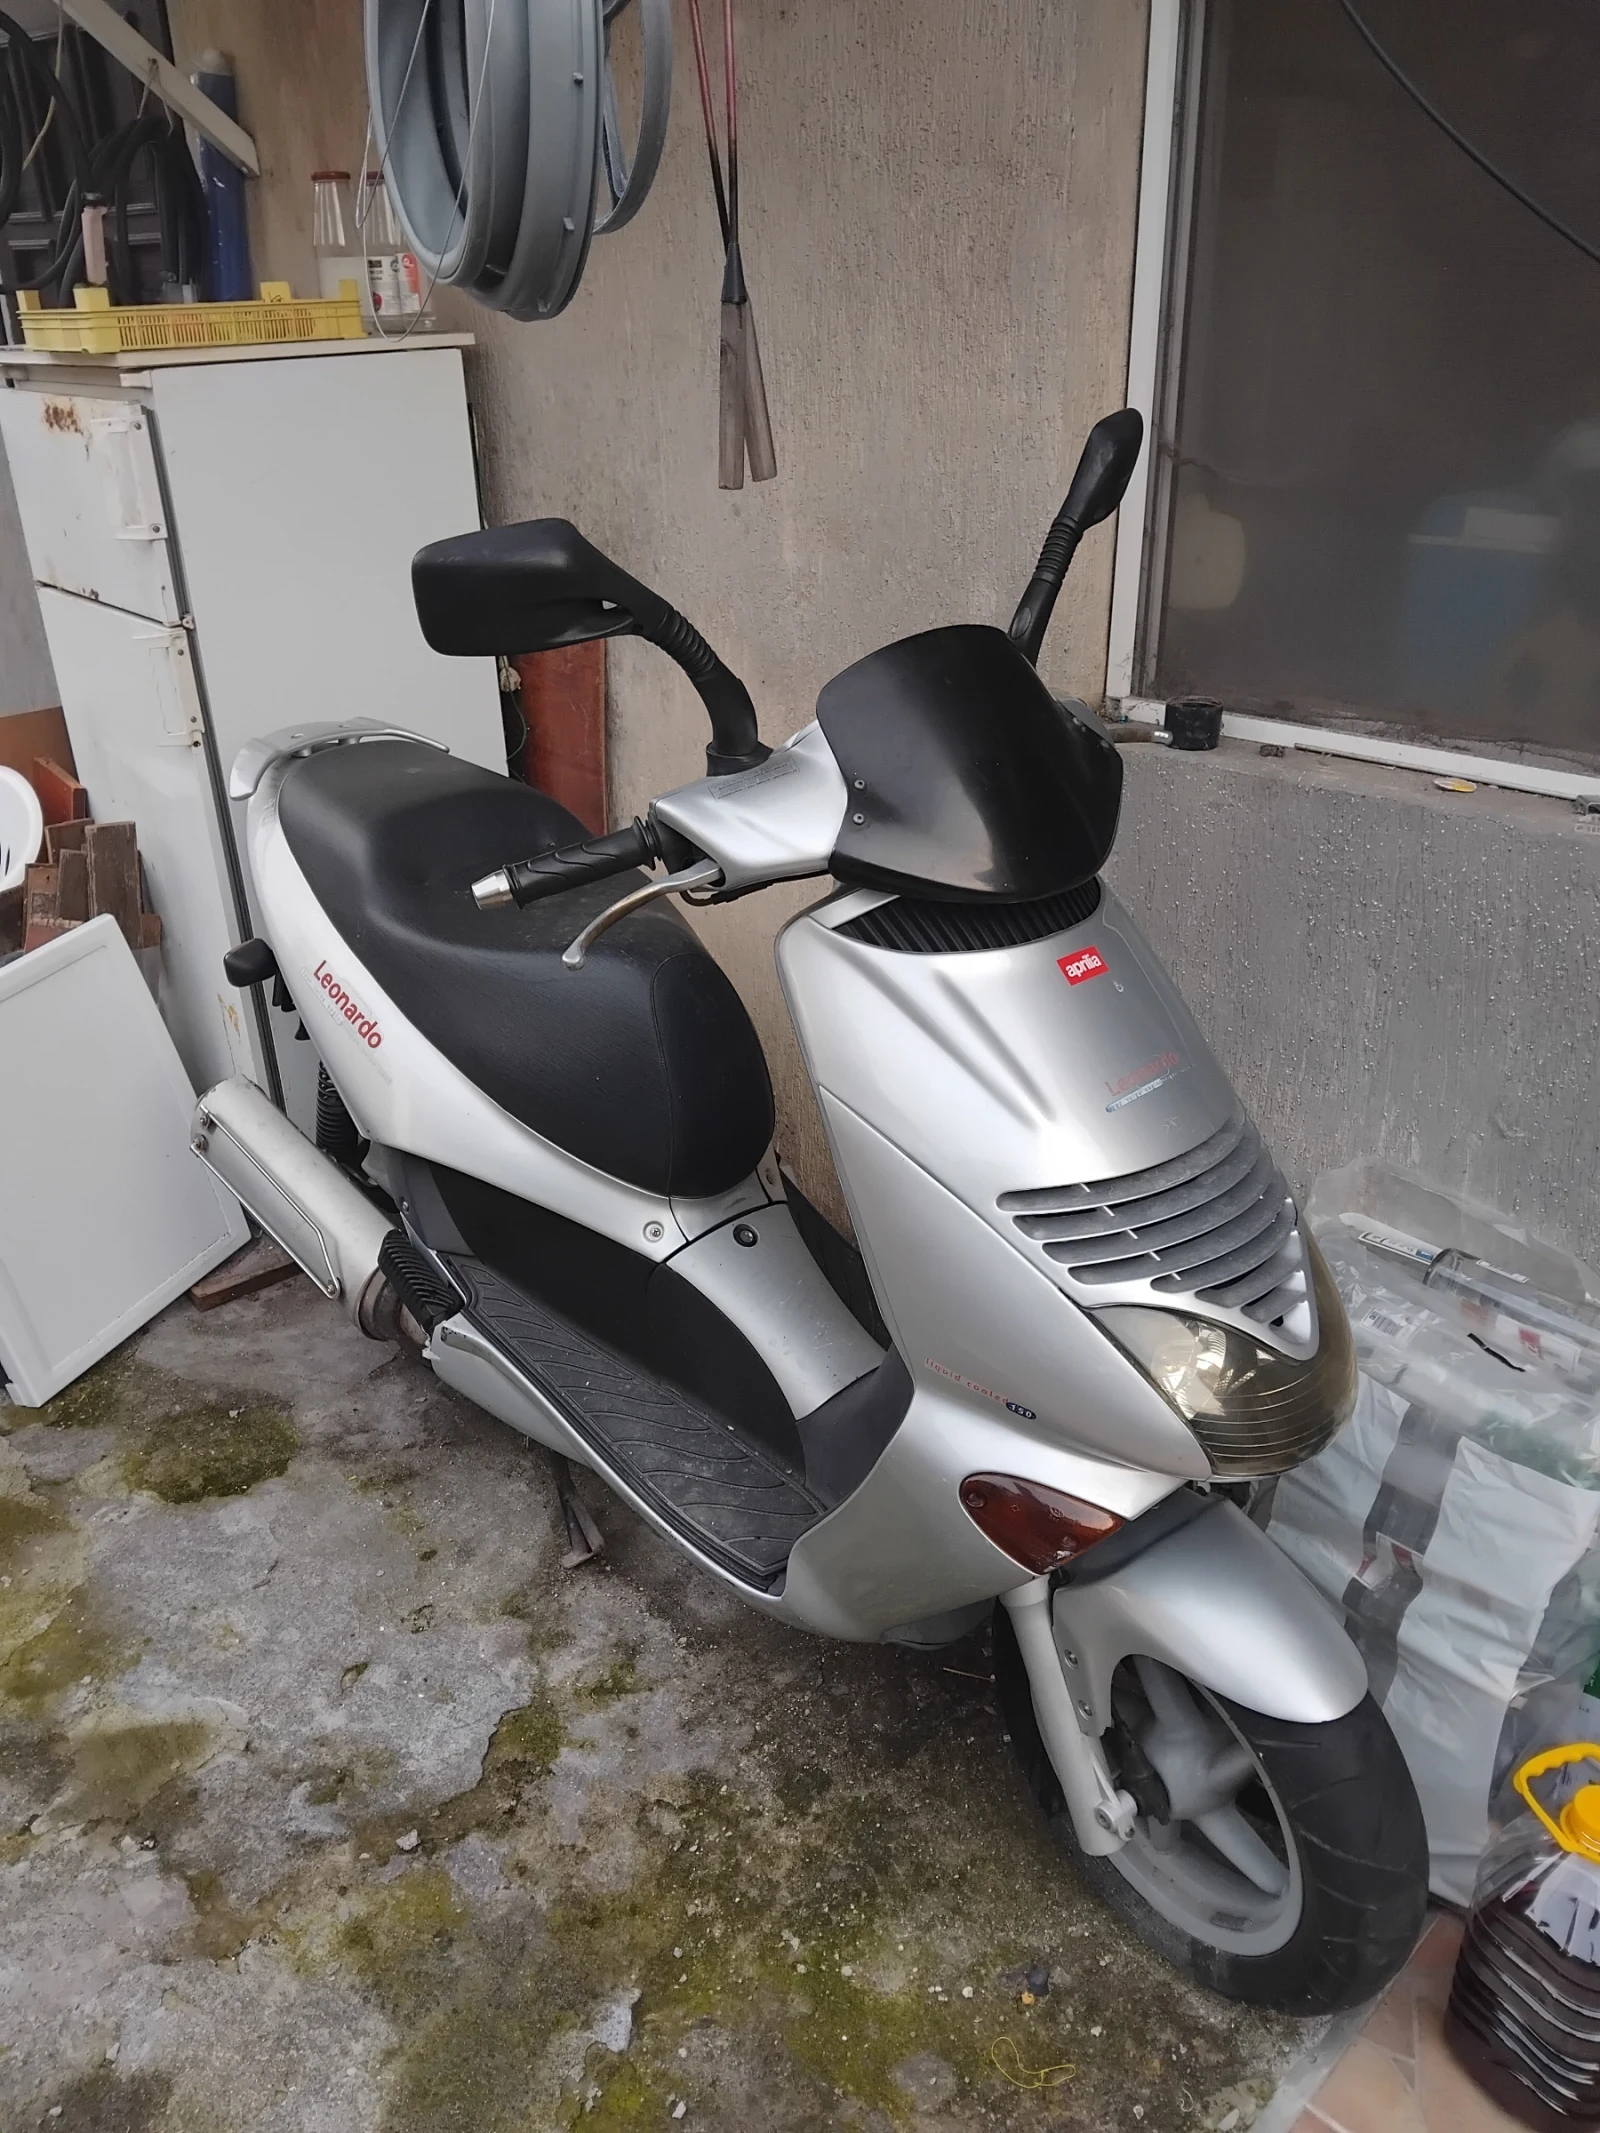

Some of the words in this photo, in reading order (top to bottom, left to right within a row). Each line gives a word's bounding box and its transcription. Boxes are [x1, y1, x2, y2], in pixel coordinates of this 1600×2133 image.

[1065, 953, 1102, 977] aprilia
[313, 959, 382, 1049] Leonardo
[925, 1357, 961, 1382] liquid
[967, 1381, 1008, 1404] cooled
[1010, 1404, 1033, 1418] 150
